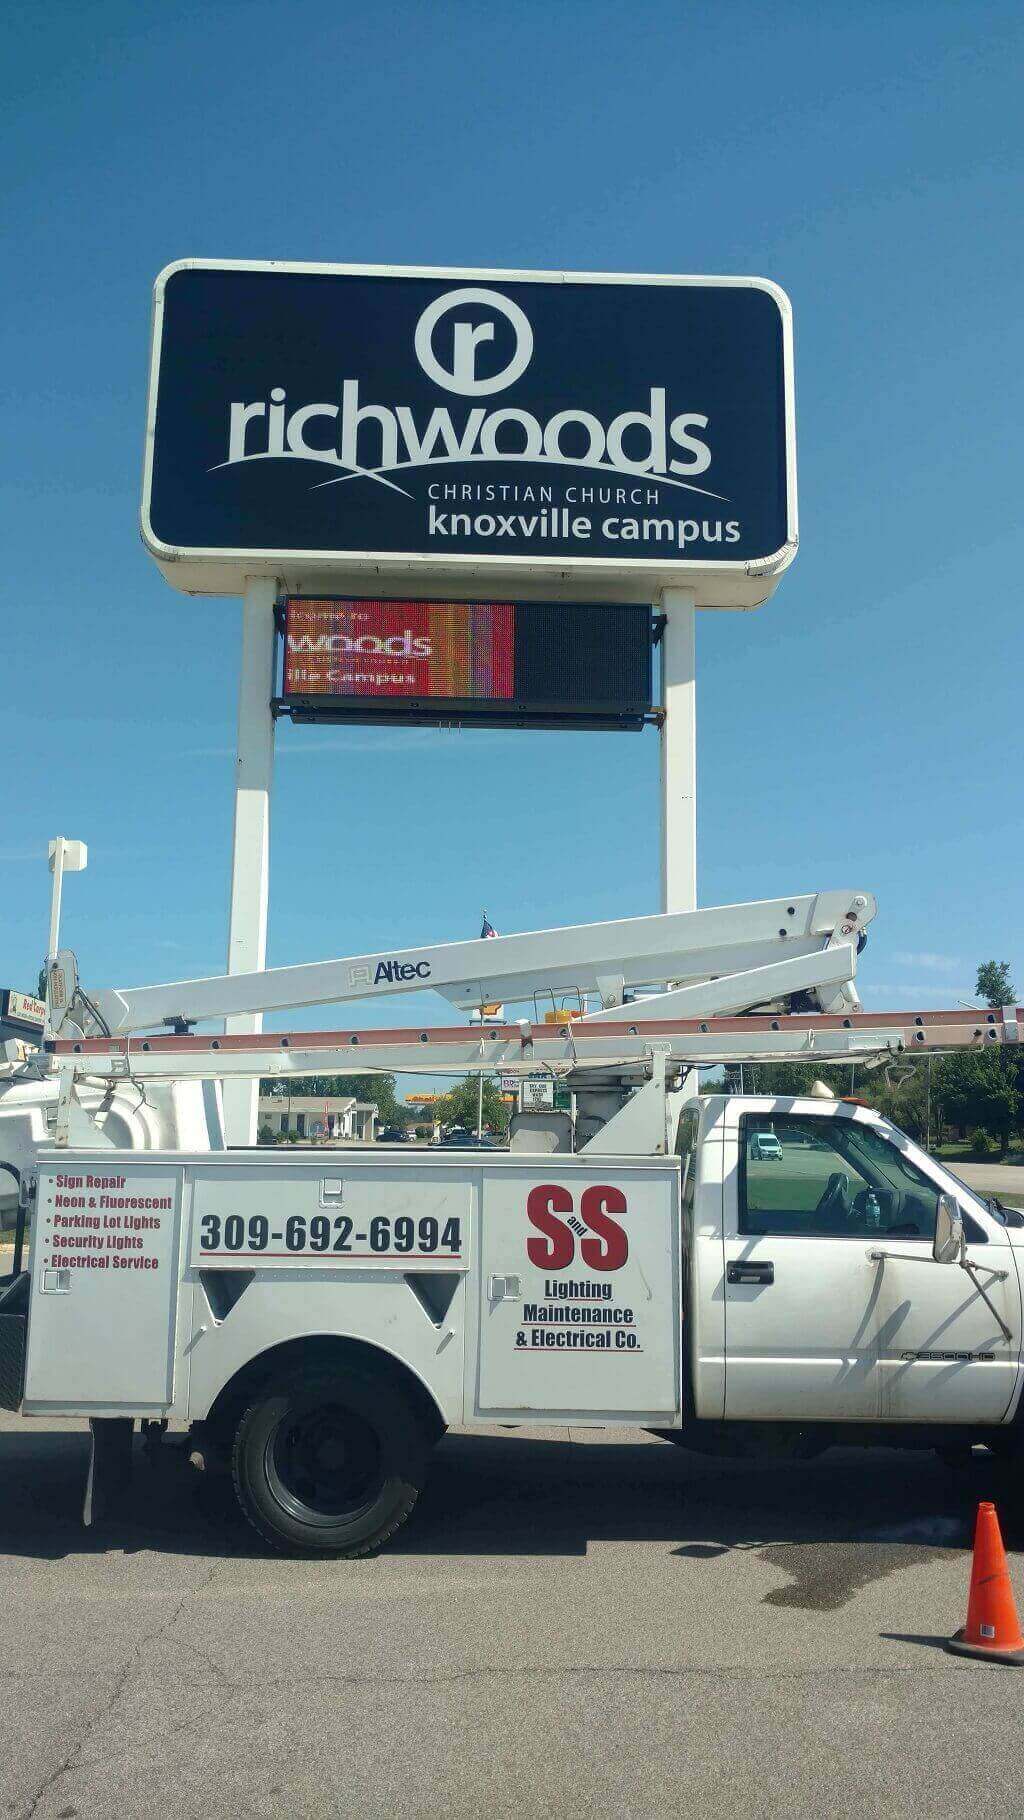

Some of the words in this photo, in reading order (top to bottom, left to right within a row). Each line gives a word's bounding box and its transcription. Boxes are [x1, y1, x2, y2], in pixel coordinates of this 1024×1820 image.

[228, 379, 712, 476] richwoods
[428, 484, 552, 502] CHRISTIAN
[566, 487, 659, 505] CHURCH
[429, 505, 592, 538] knoxville
[602, 517, 741, 549] campus
[327, 668, 416, 685] Campus
[373, 960, 432, 985] Altec
[56, 1175, 83, 1189] Sign
[86, 1175, 126, 1189] Repair
[55, 1195, 86, 1208] Neon
[88, 1196, 97, 1208] &
[99, 1195, 172, 1210] Fluorescent
[53, 1214, 101, 1230] Parking
[103, 1215, 121, 1229] Lot
[123, 1215, 161, 1230] Lights
[527, 1184, 575, 1271] S
[566, 1215, 589, 1238] and
[580, 1185, 629, 1272] S
[52, 1234, 104, 1250] Security
[106, 1235, 144, 1250] Lights
[200, 1214, 462, 1253] 309-692-6994
[51, 1255, 110, 1269] Electrical
[112, 1255, 159, 1270] Service
[544, 1279, 613, 1300] Lighting
[523, 1303, 634, 1324] Maintenance
[515, 1330, 528, 1347] &
[531, 1328, 611, 1348] Electrical
[615, 1330, 641, 1349] Co.
